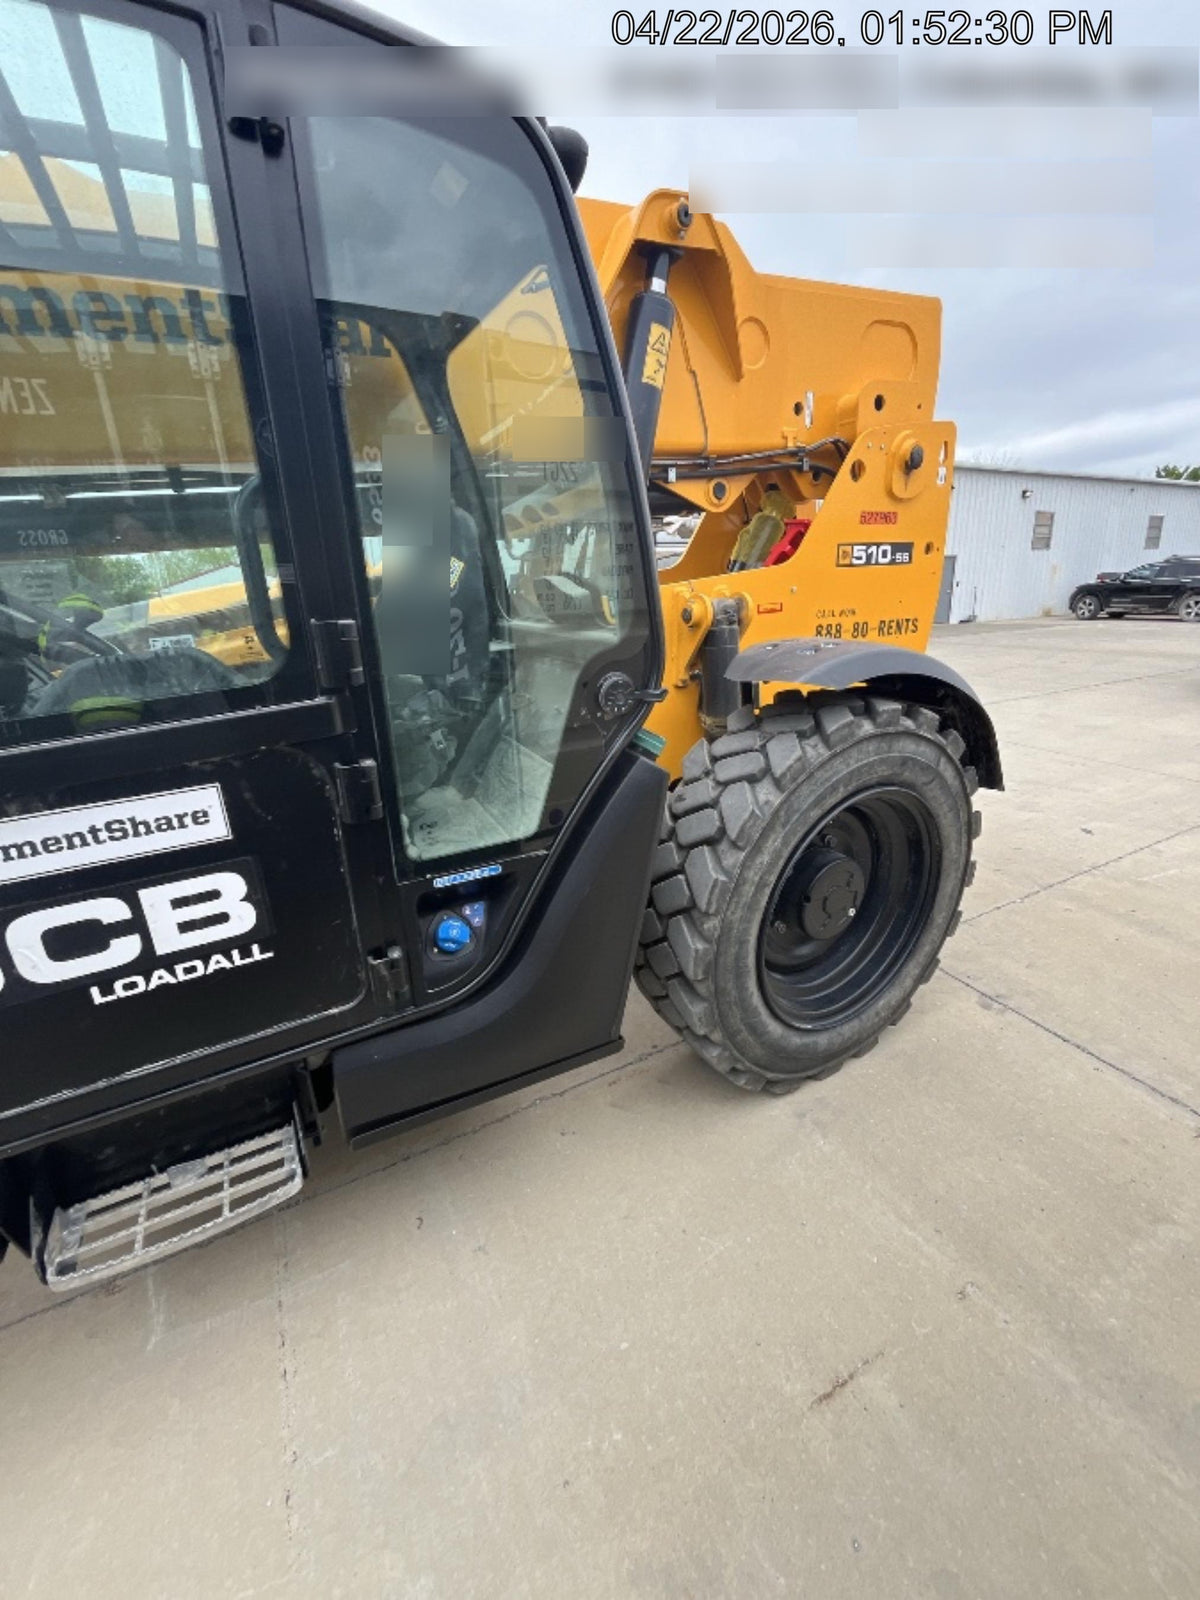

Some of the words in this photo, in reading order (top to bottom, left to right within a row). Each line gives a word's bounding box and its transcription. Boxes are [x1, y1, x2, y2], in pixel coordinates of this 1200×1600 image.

[0, 808, 211, 862] mentShare
[0, 871, 258, 993] CB
[90, 943, 274, 1005] LOADALL
